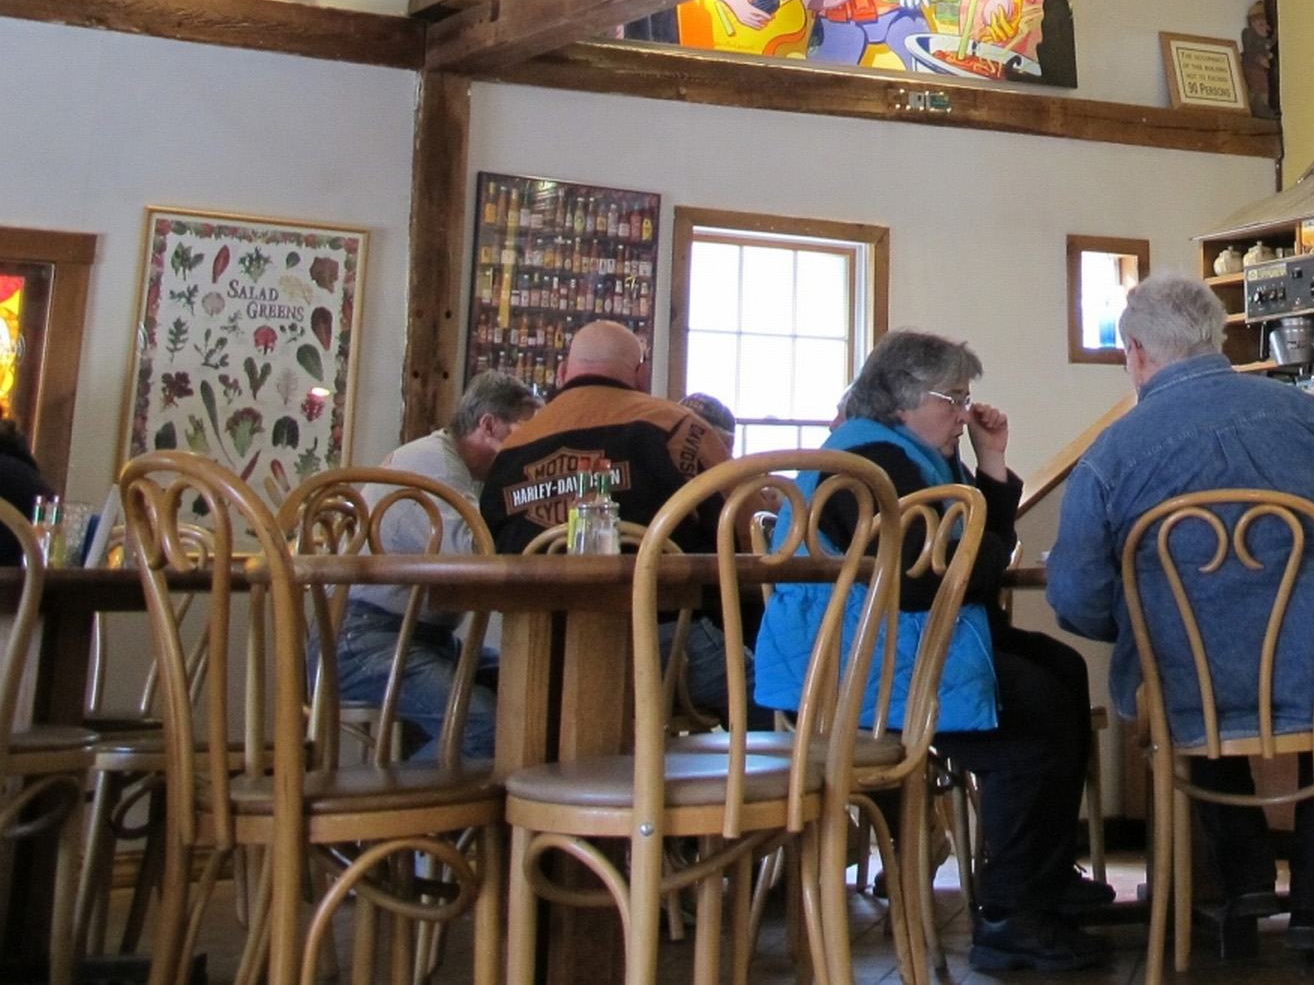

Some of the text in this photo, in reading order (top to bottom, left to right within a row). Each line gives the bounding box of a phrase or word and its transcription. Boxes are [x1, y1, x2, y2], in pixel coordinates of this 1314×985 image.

[227, 279, 278, 302] SALAD
[246, 300, 305, 323] GREENS
[680, 422, 706, 474] DAVIDS
[535, 454, 590, 478] MOTO
